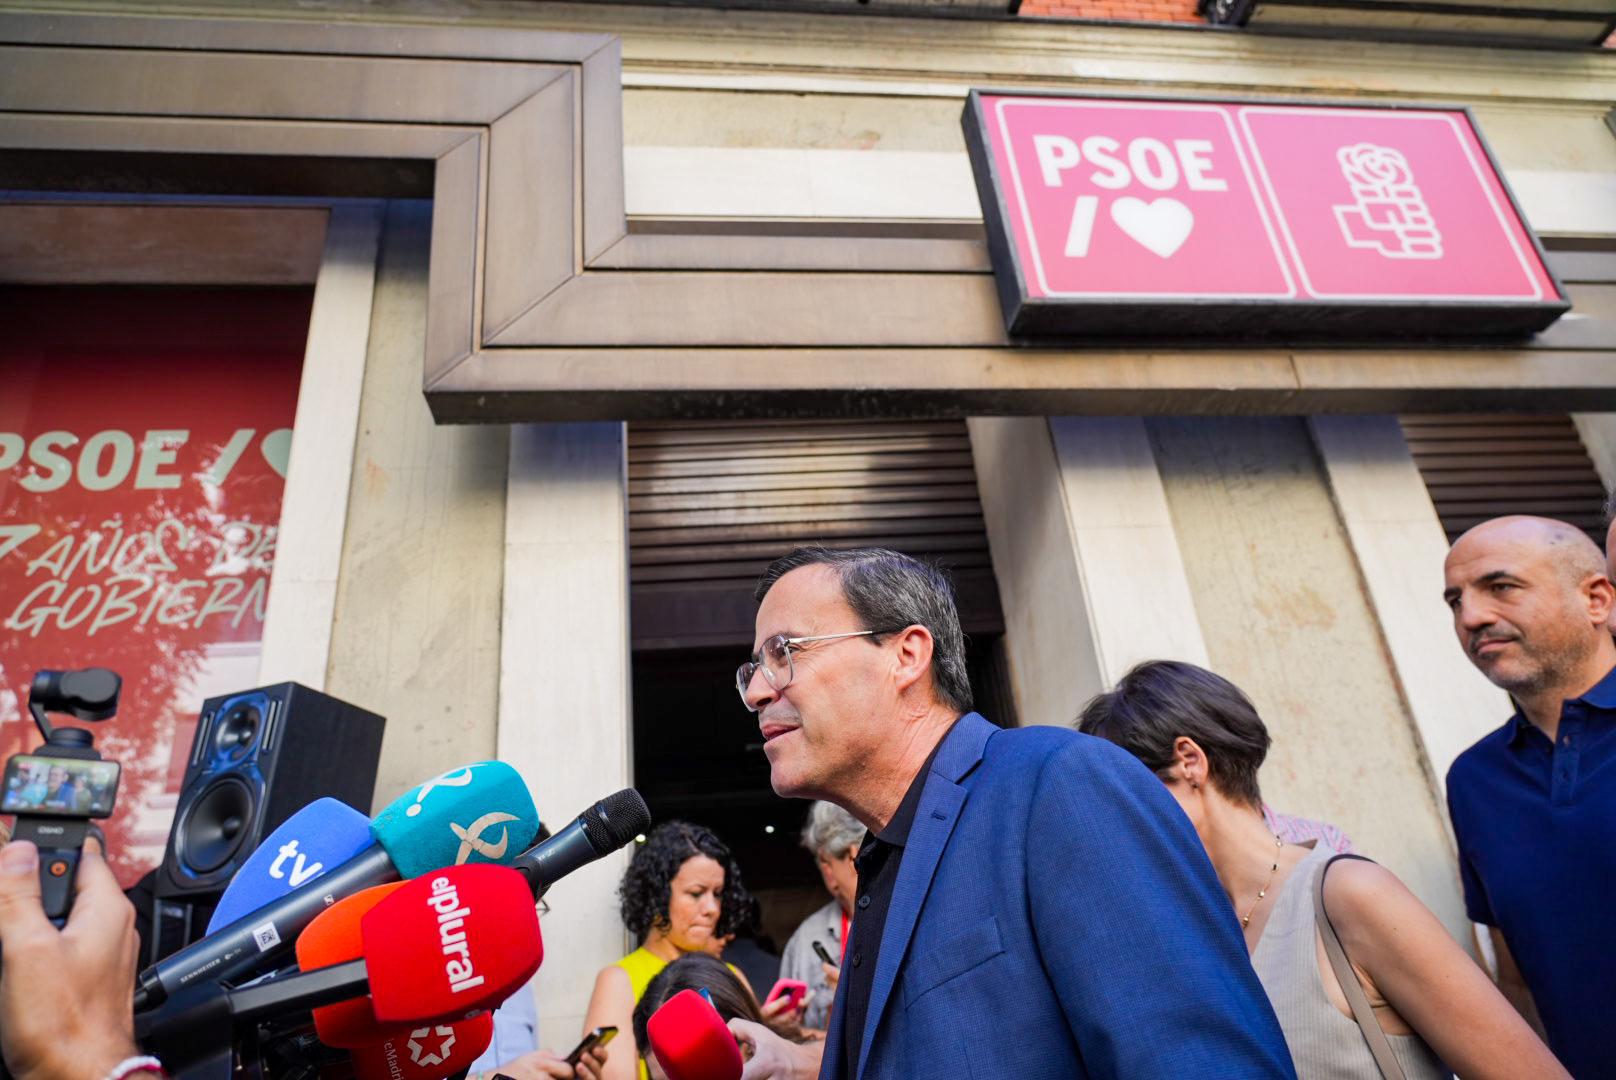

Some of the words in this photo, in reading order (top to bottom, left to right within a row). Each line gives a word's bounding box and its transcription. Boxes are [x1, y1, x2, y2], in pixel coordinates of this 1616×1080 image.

[1033, 134, 1229, 192] PSOE
[25, 518, 188, 582] AÑOS
[269, 839, 323, 887] tv
[427, 876, 485, 993] elplural
